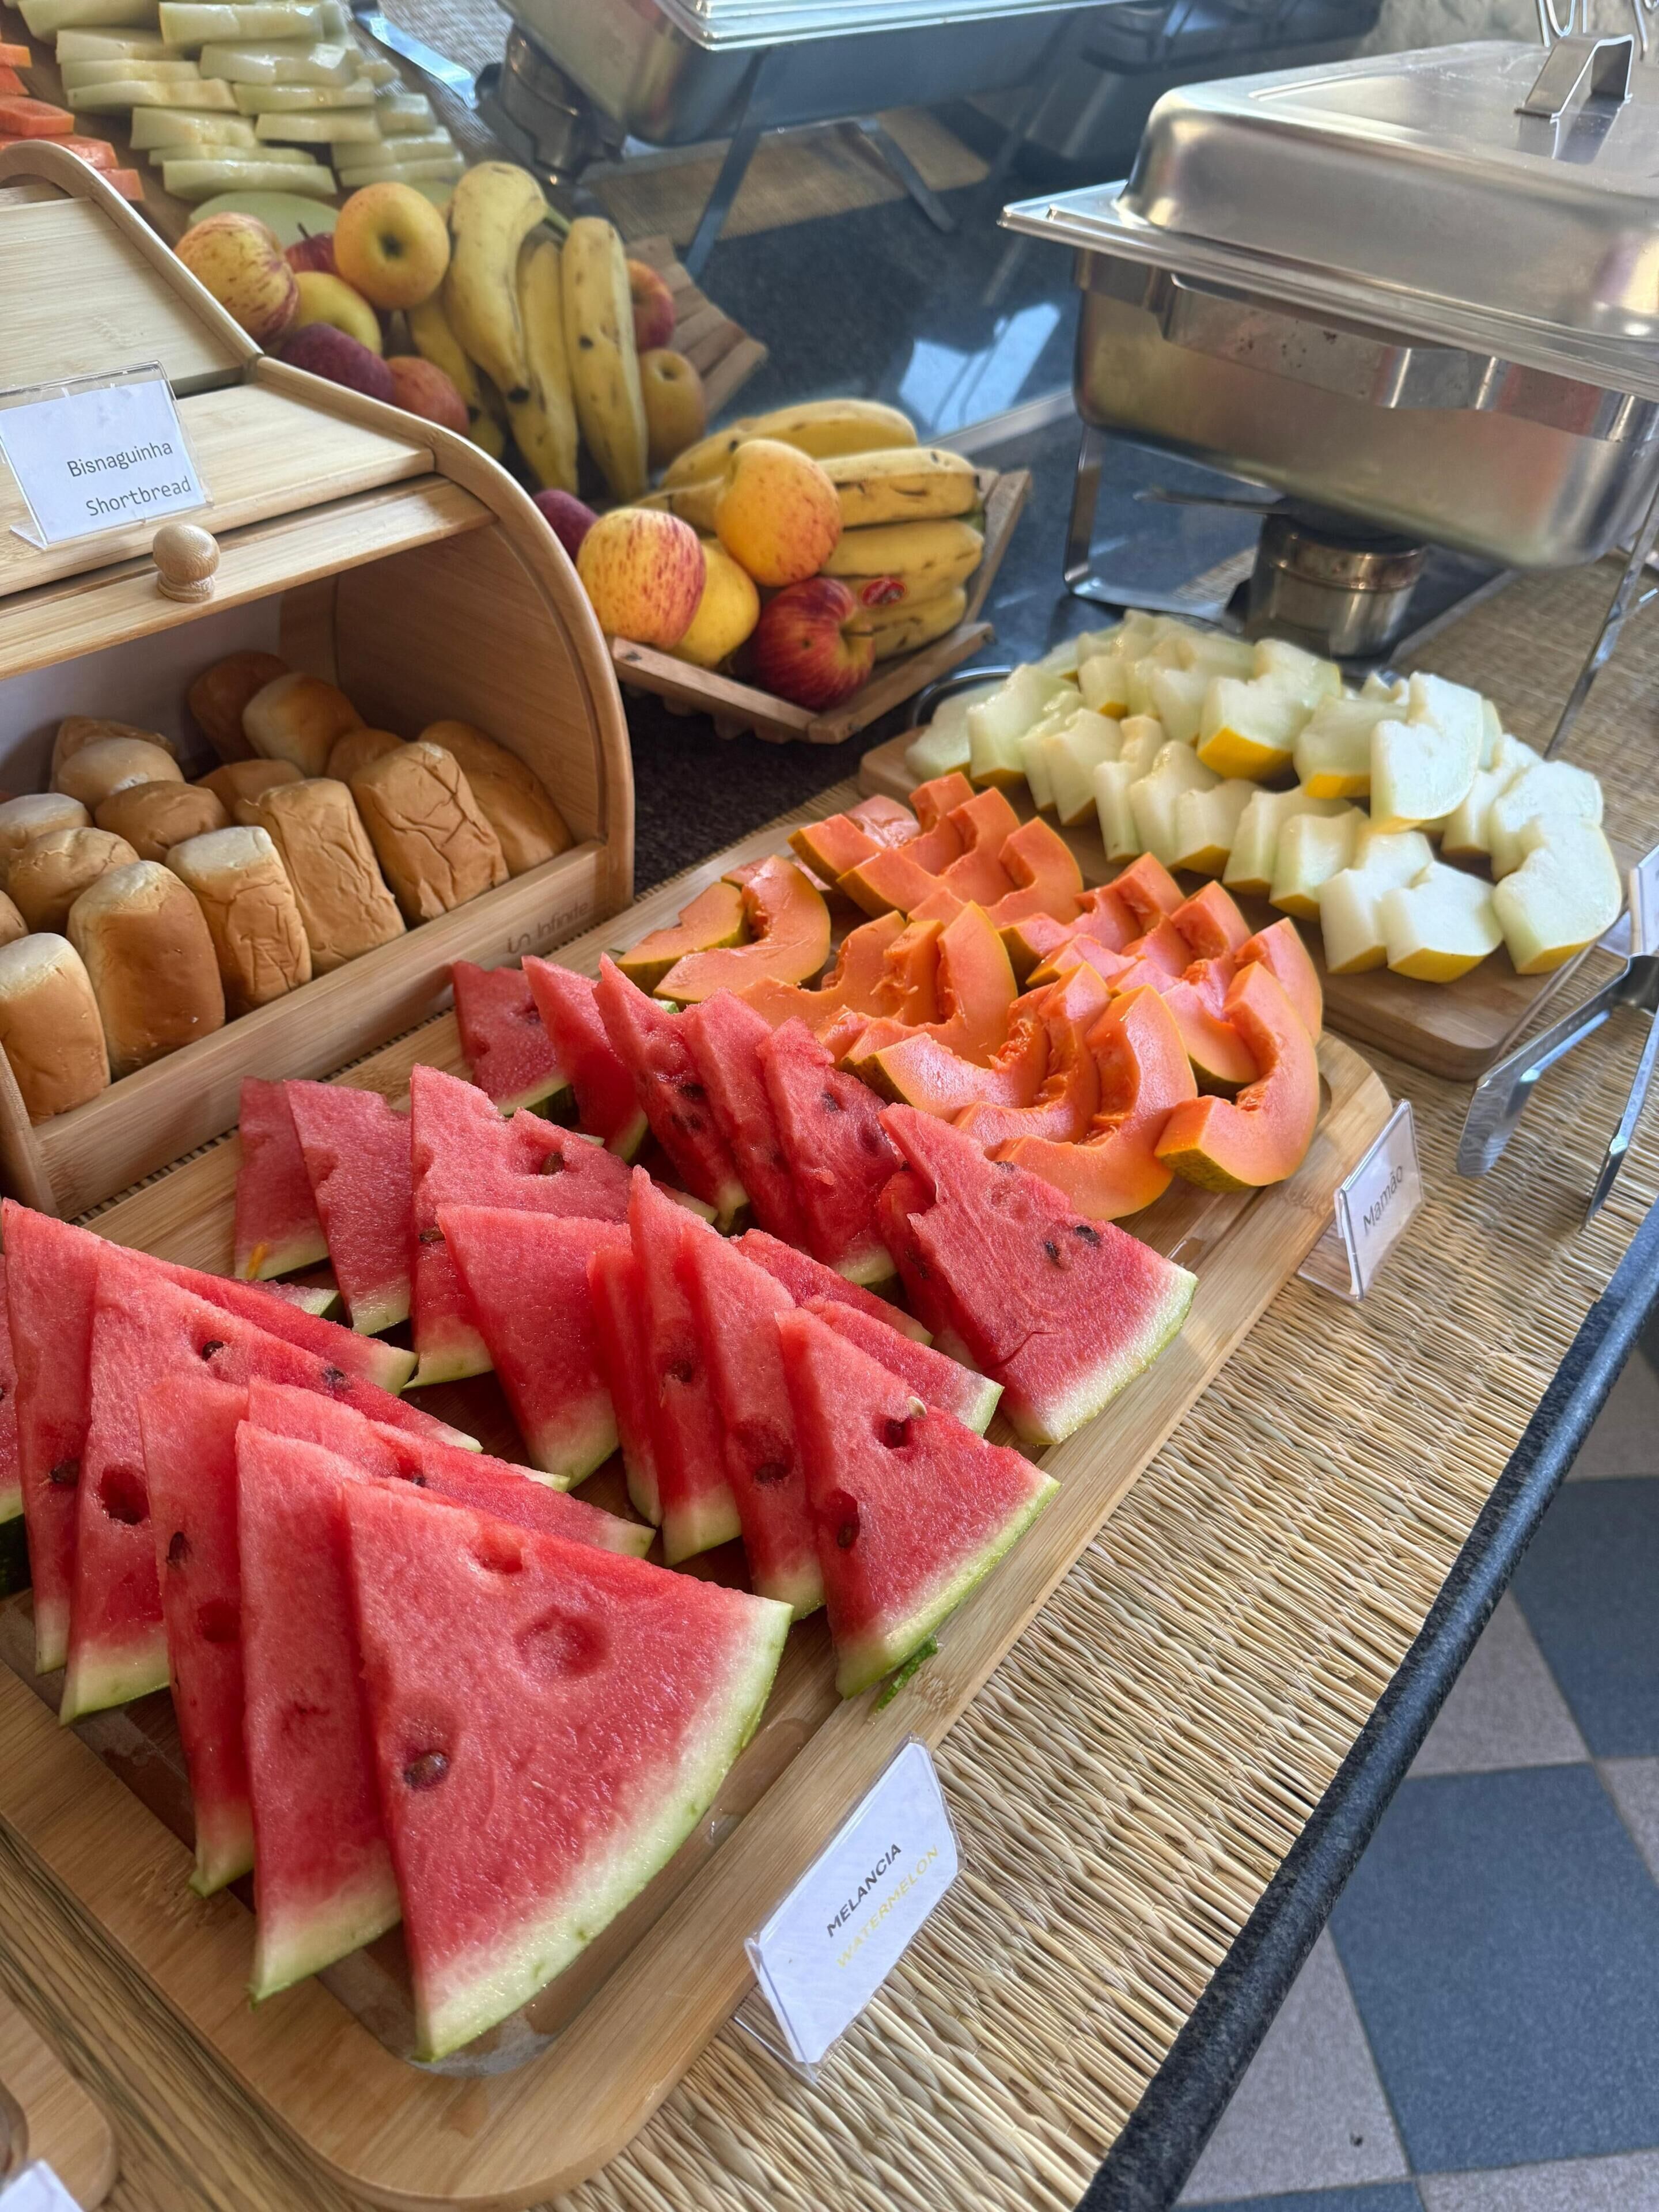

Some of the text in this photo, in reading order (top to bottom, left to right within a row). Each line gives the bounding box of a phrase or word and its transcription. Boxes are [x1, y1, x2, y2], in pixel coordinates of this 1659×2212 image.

[67, 442, 173, 477] Bisnaguinha
[86, 476, 192, 516] Shortbread
[1362, 1165, 1403, 1236] Mamão
[825, 1843, 902, 1937] MELANCIA
[835, 1846, 938, 1968] WATERMELON
